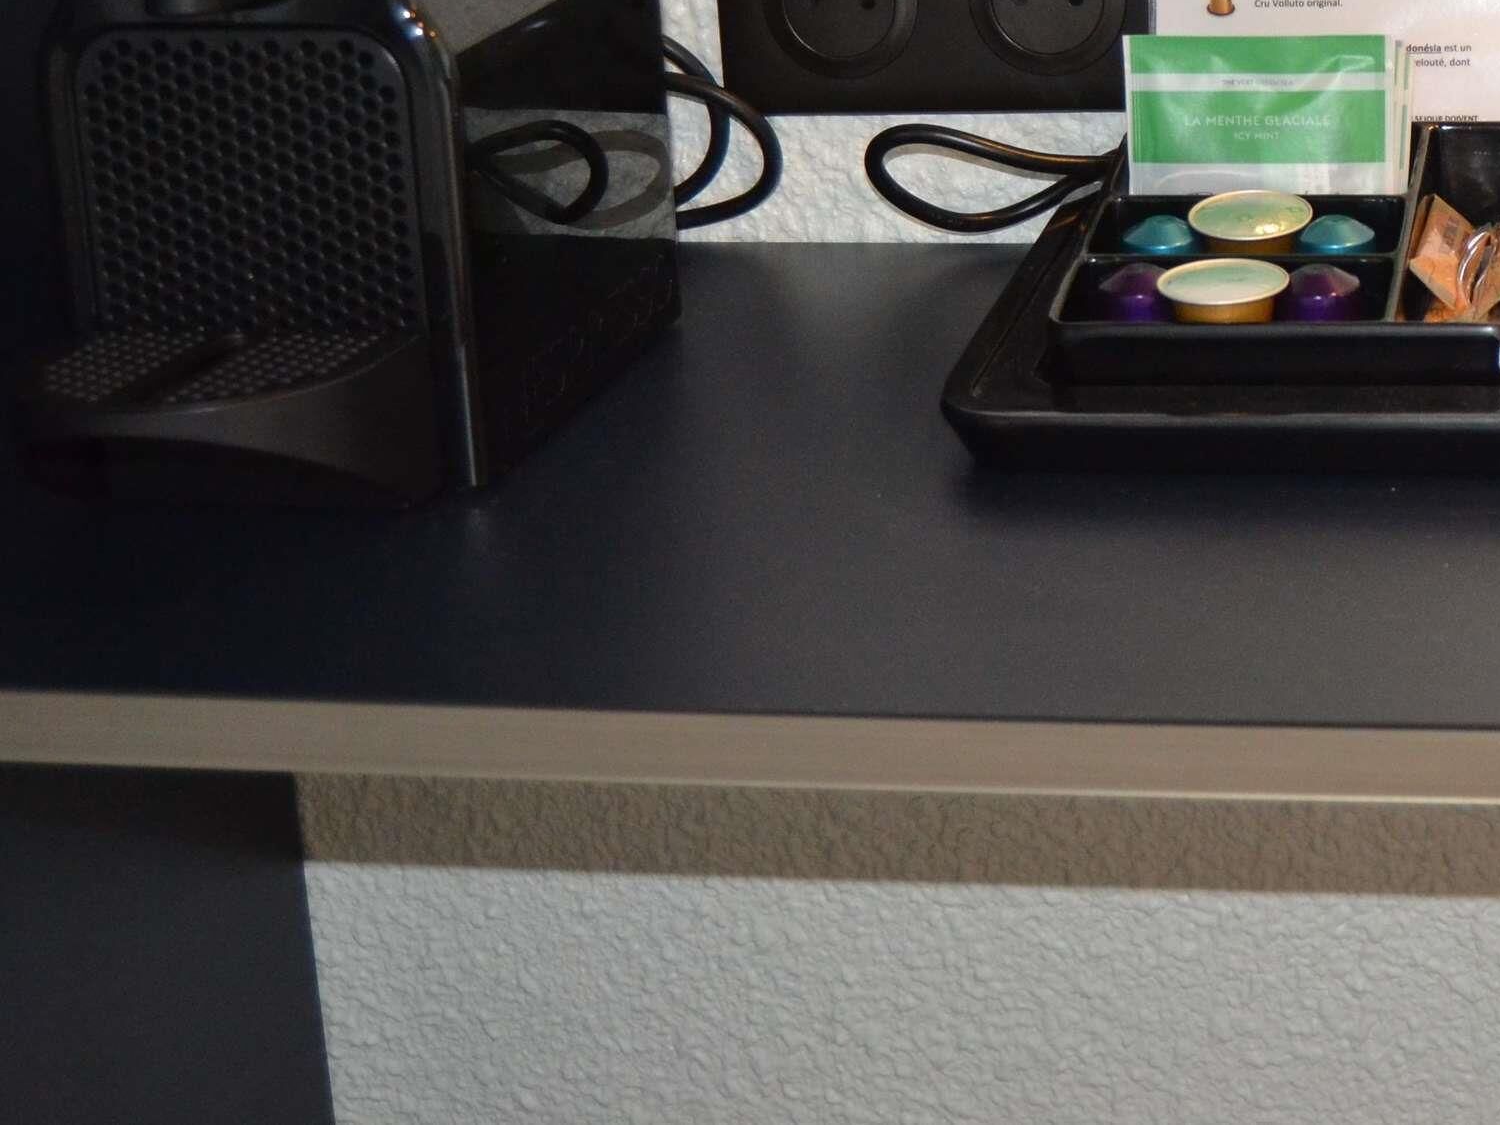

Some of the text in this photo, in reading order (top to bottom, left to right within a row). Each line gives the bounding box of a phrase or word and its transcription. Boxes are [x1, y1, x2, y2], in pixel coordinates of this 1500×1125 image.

[1406, 43, 1472, 54] donésia est un
[1415, 57, 1471, 68] elouté, dont
[1205, 114, 1262, 127] MENTHE
